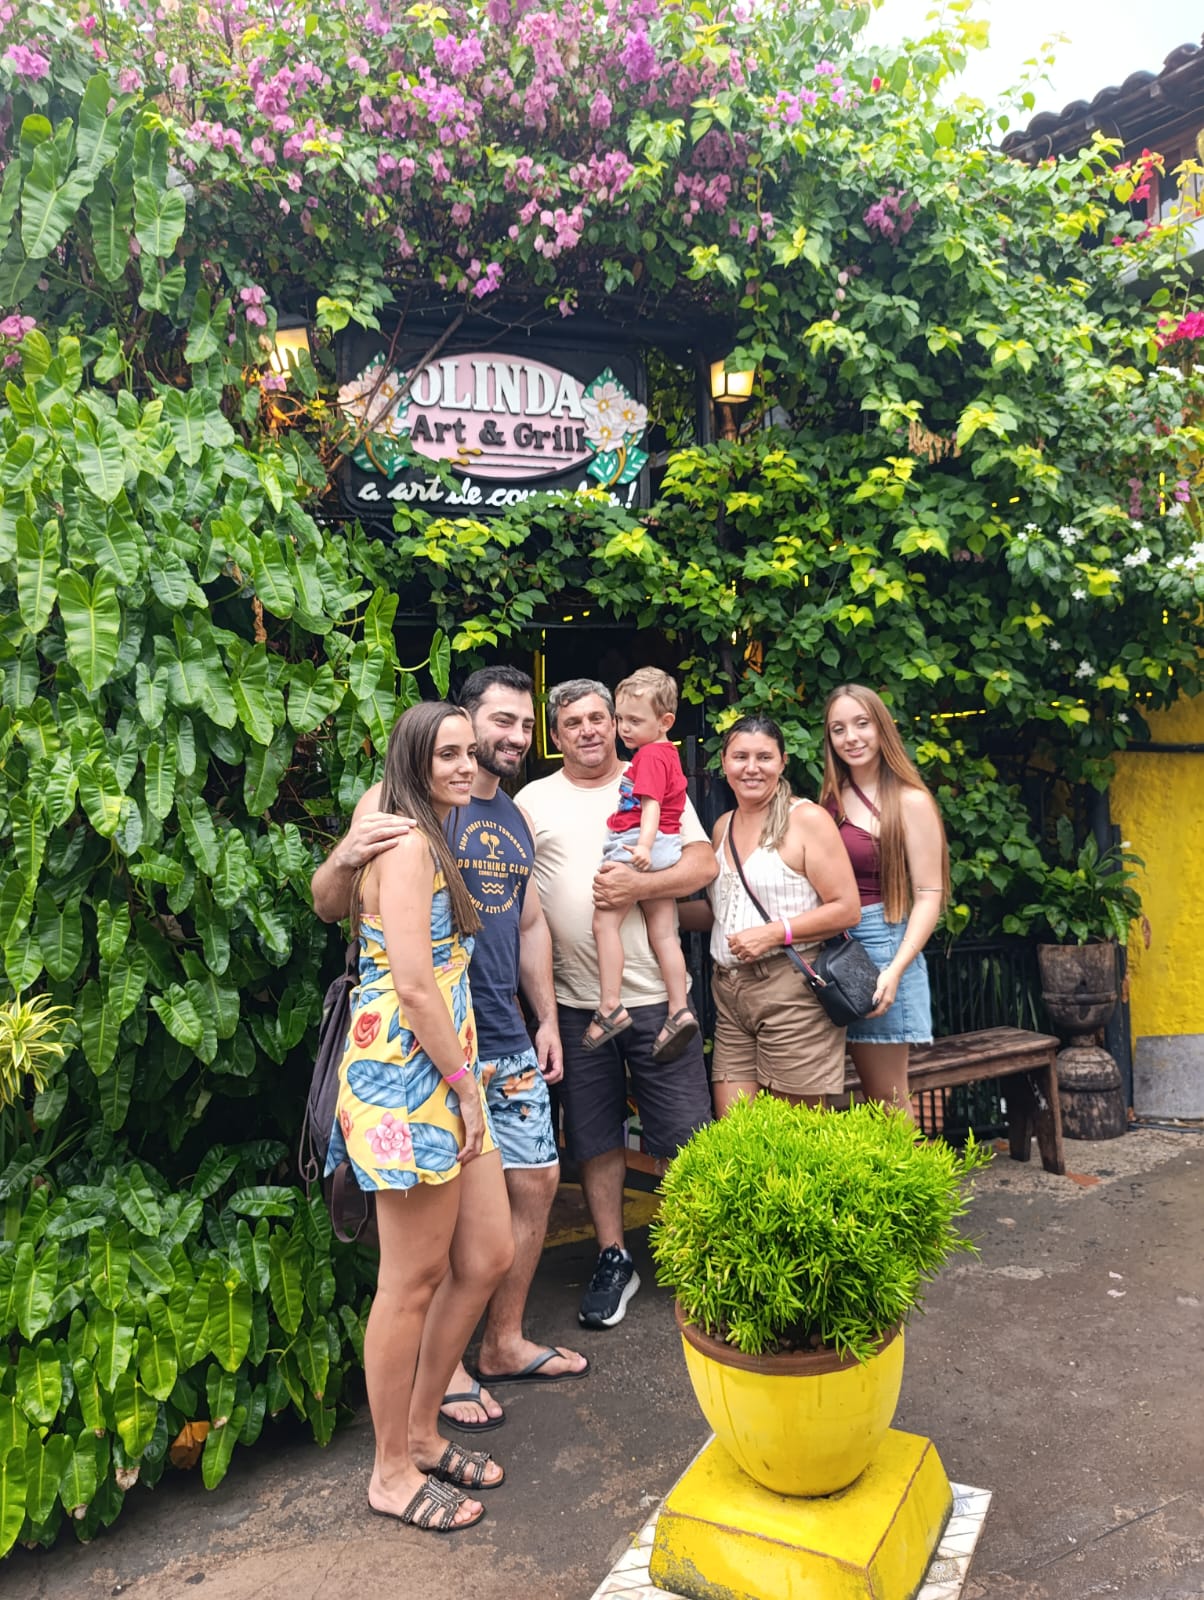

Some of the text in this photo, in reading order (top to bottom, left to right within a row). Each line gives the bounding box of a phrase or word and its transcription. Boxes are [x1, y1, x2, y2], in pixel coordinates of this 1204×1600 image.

[408, 361, 586, 420] OLINDA
[410, 414, 586, 452] Art & Grill
[482, 820, 497, 829] LAZY
[457, 858, 529, 876] DO NOTHING CLUB
